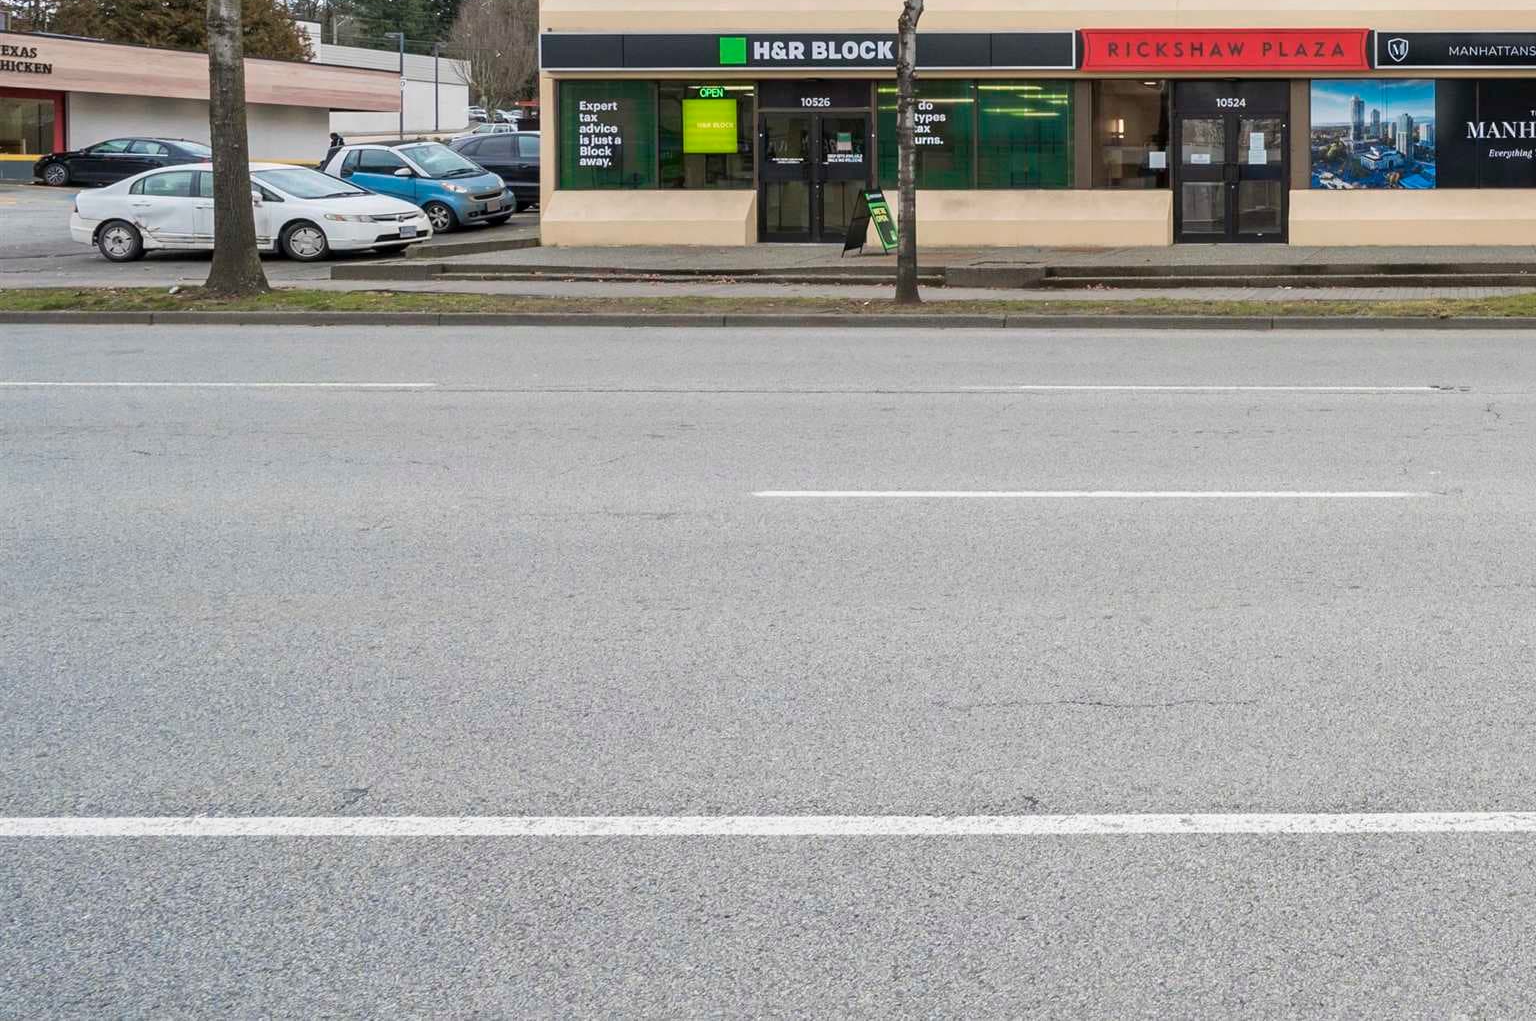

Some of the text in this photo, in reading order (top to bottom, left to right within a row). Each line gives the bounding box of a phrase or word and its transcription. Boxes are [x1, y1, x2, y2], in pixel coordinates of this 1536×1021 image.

[0, 44, 38, 59] EXAS
[753, 40, 894, 60] H&R BLOCK
[1108, 41, 1345, 58] RICKSHAW PLAZA
[0, 60, 53, 75] HICKEN
[700, 88, 724, 98] OPEN
[579, 101, 618, 112] Expert
[801, 97, 831, 107] 10526
[918, 99, 933, 111] do
[1216, 98, 1247, 108] 10524
[579, 113, 598, 122] tax
[914, 112, 947, 124] types
[579, 123, 618, 133] advice
[914, 125, 931, 133] ax
[579, 134, 622, 146] is just a
[914, 136, 944, 145] urns.
[579, 146, 612, 156] Block
[1488, 149, 1533, 159] Everything
[579, 158, 612, 168] away.
